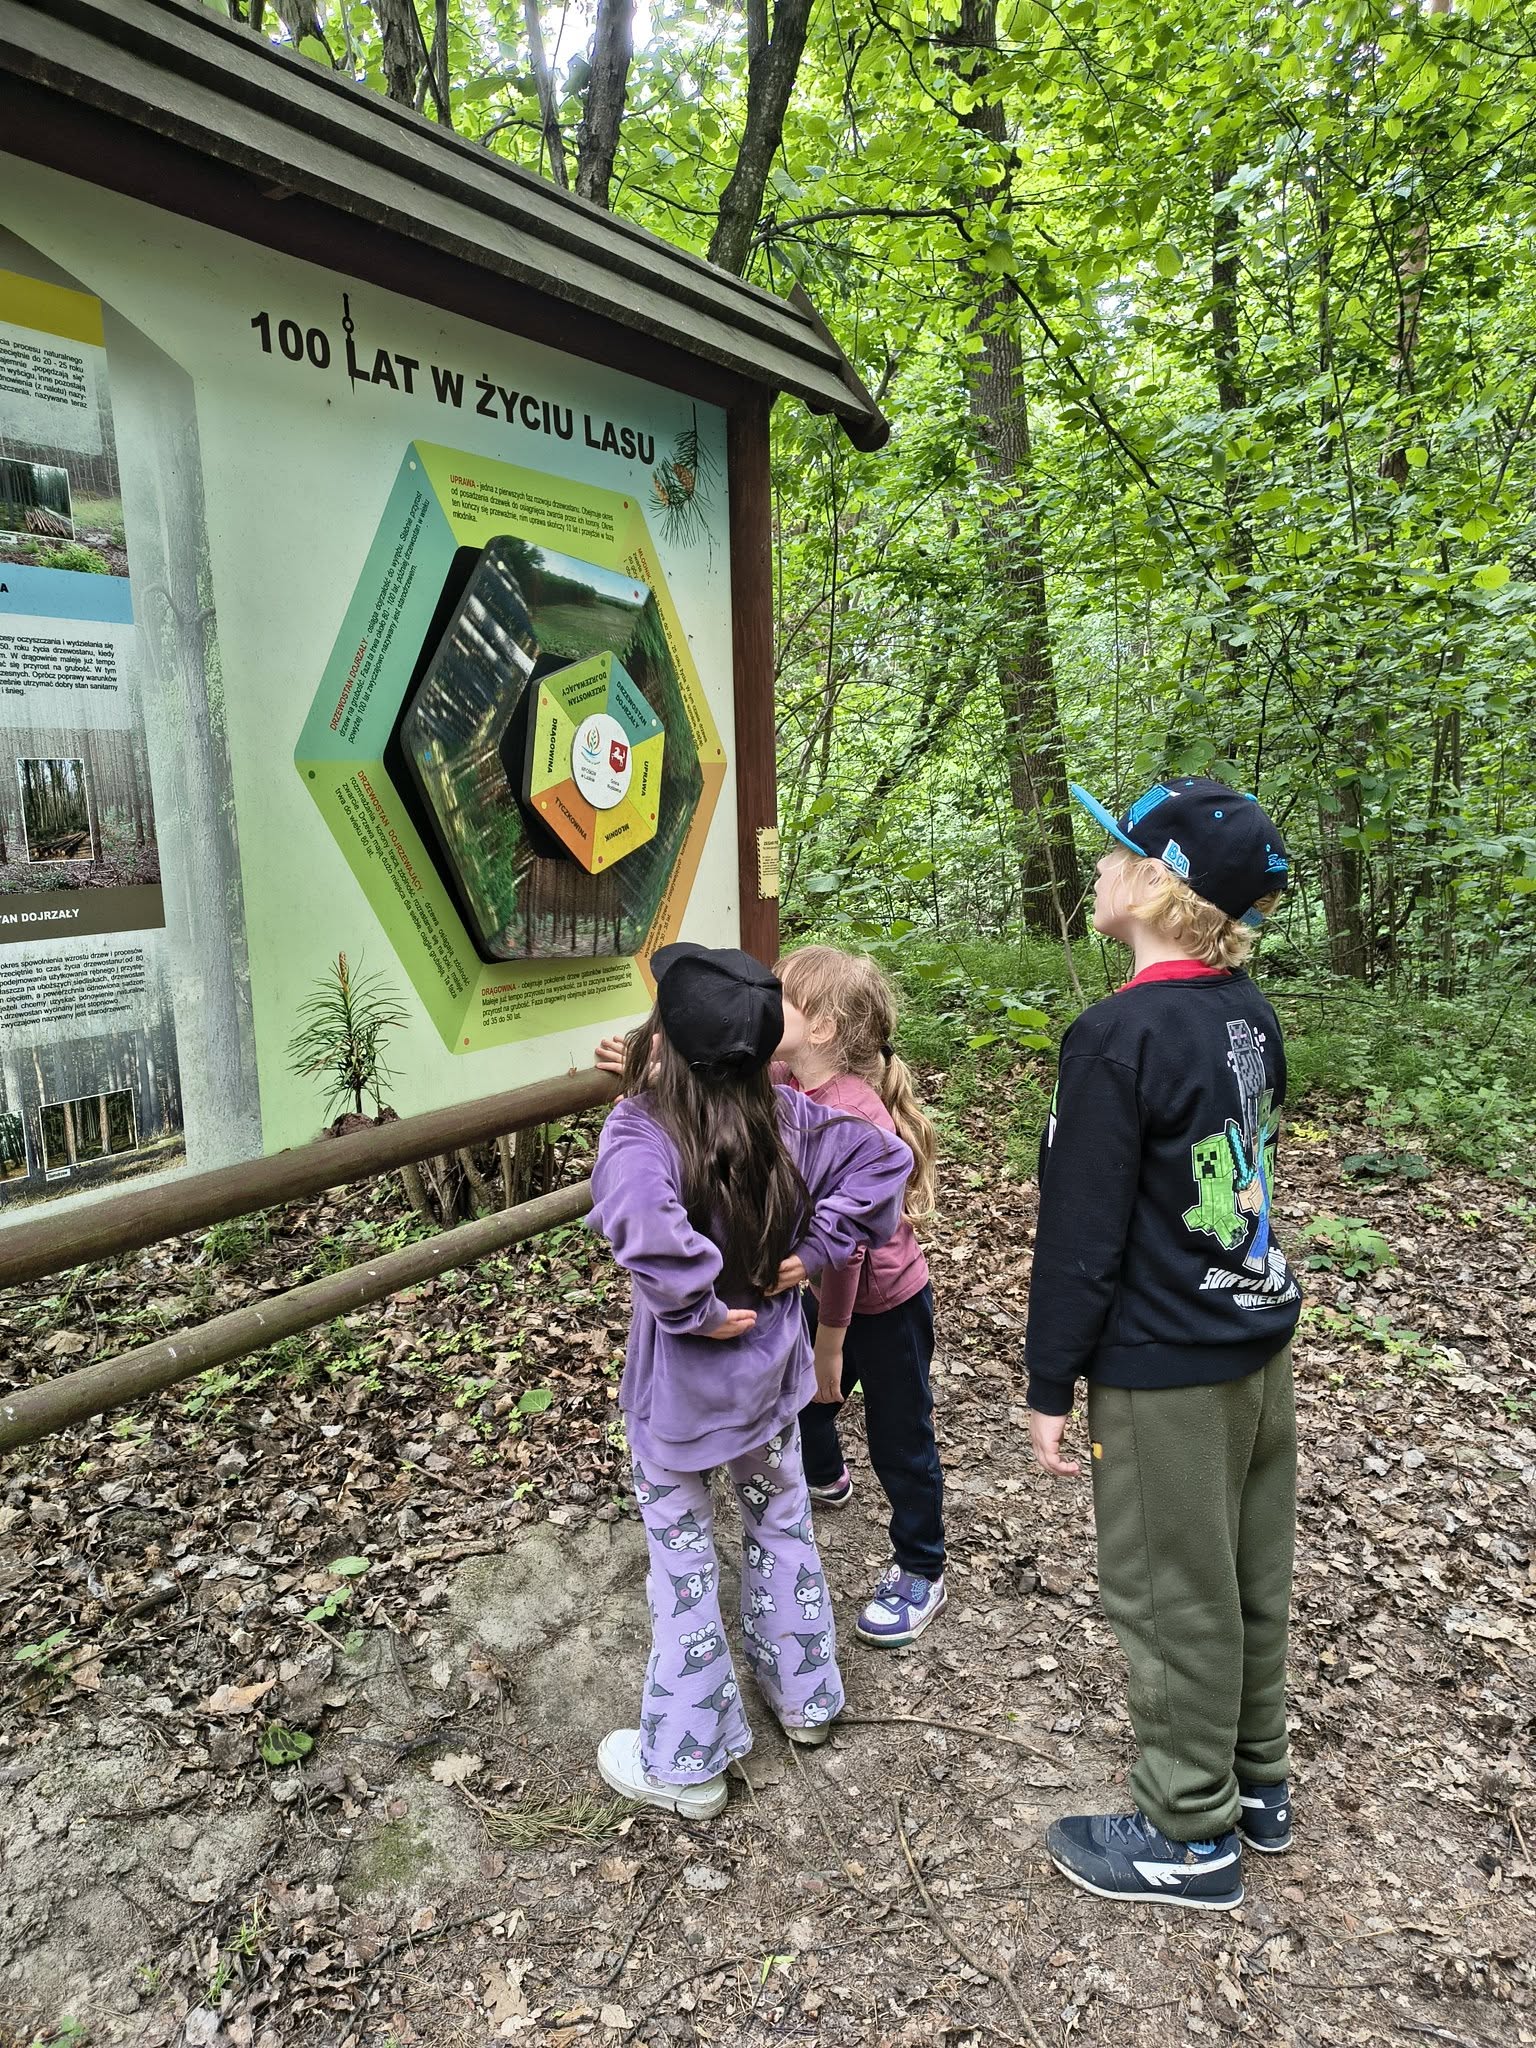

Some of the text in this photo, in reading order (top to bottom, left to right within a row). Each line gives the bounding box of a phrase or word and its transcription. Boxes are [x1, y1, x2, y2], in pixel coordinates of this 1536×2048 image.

[13, 342, 41, 354] procesu
[43, 350, 83, 364] naturalnego
[43, 356, 52, 365] 20
[59, 361, 68, 370] 25
[69, 364, 84, 373] roku
[39, 374, 86, 392] inne pozostają
[44, 385, 67, 396] nalotu)
[251, 311, 655, 465] 100 LAT W ŻYCIU LASU
[35, 392, 88, 408] nazywane teraz
[450, 475, 494, 492] UPRAWA jedna
[460, 490, 488, 502] posadzenia
[462, 500, 480, 513] kończy
[638, 548, 652, 580] MŁODNIK
[17, 636, 61, 645] oczyszczania
[66, 640, 103, 648] wydzielania
[104, 642, 114, 650] się
[33, 646, 50, 654] życia
[53, 647, 95, 656] drzewostanu,
[98, 650, 114, 658] kiedy
[330, 679, 353, 730] DRZEWOSTAN
[349, 638, 367, 678] DOJRZAŁY
[367, 611, 378, 633] osiąga
[386, 568, 394, 577] do
[10, 661, 20, 670] się
[22, 654, 58, 662] drągowinie
[60, 656, 82, 664] maleje
[96, 658, 116, 666] tempo
[338, 716, 350, 736] drzew
[347, 706, 354, 716] na
[360, 660, 371, 678] Faza
[386, 592, 396, 605] 100
[32, 671, 56, 679] Oprócz
[58, 674, 84, 682] poprawy
[55, 681, 74, 690] dobry
[348, 715, 362, 744] powyżej
[357, 701, 366, 714] 100
[366, 653, 384, 692] zwyczajowo
[381, 620, 397, 653] nazywany
[562, 672, 607, 698] DOJRZEWAJĄCY
[568, 684, 606, 706] DRZEWOSTAN
[616, 681, 648, 726] DRZEWOSTAN
[616, 695, 640, 729] DOJRZAŁY
[548, 718, 558, 774] DRĄGOWINA
[641, 760, 650, 796] UPRAWA
[335, 787, 374, 858] trwa do wieku lat.
[555, 797, 588, 841] TYCZKOWINA
[604, 822, 630, 842] MŁODNIK
[342, 782, 359, 812] zwarcie.
[358, 811, 374, 839] Drzewa
[372, 839, 383, 858] mają
[381, 856, 392, 874] dużo
[390, 874, 405, 899] miejsca
[403, 899, 411, 910] dla
[350, 776, 375, 823] rozmnażania,
[375, 824, 389, 848] korony
[388, 848, 399, 868] tracą
[436, 945, 444, 955] na
[357, 770, 470, 986] DRZEWOSTAN DOJRZEWAJĄCY drzewa osiągają zdolność
[21, 908, 80, 922] DOJRZAŁY
[21, 958, 63, 968] spowolnienia
[114, 948, 142, 957] procesów
[111, 972, 146, 980] drzewostan
[43, 988, 84, 998] powierzchnia
[87, 983, 120, 992] odnowiona
[79, 992, 114, 1000] odnowienie
[482, 984, 516, 996] DRĄGOWINA
[4, 1010, 42, 1020] drzewostan
[44, 1004, 74, 1014] wycinany
[88, 998, 118, 1007] stopniowo
[483, 1006, 502, 1018] przyrost
[1, 1018, 40, 1028] zwyczajowo
[42, 1013, 74, 1022] nazywany
[483, 1018, 490, 1027] od
